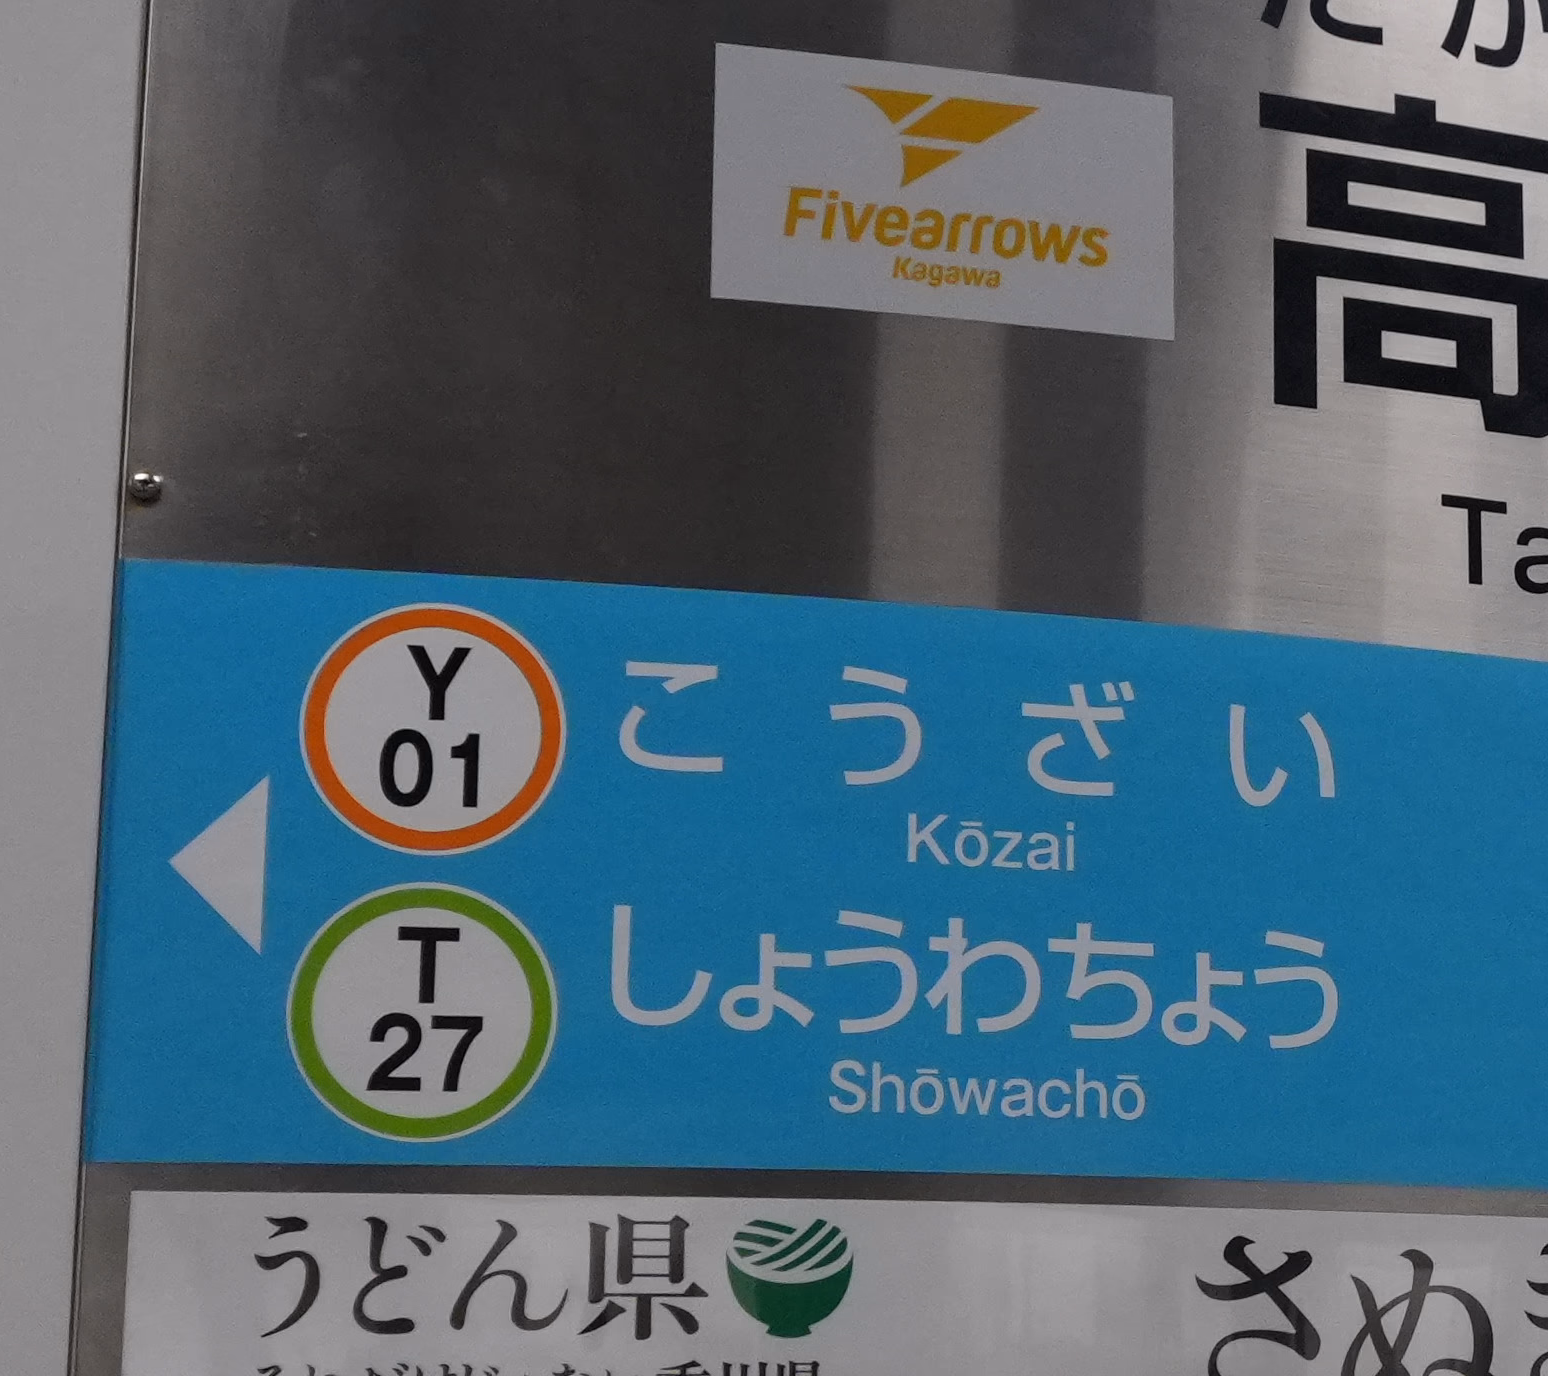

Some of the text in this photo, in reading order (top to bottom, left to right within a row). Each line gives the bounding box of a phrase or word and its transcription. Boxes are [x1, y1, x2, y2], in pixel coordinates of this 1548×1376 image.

[782, 185, 1110, 270] Fivearrows
[892, 254, 1002, 290] Kagawa
[407, 645, 472, 719] Y
[379, 729, 482, 809] 01
[617, 661, 1336, 807] こうざい
[906, 812, 1077, 873] Kōzai
[398, 927, 459, 1004] T
[610, 904, 1339, 1050] しょうわちょう
[367, 1015, 484, 1091] 27
[828, 1058, 1146, 1121] Shōwachō
[249, 1215, 710, 1342] うどん県
